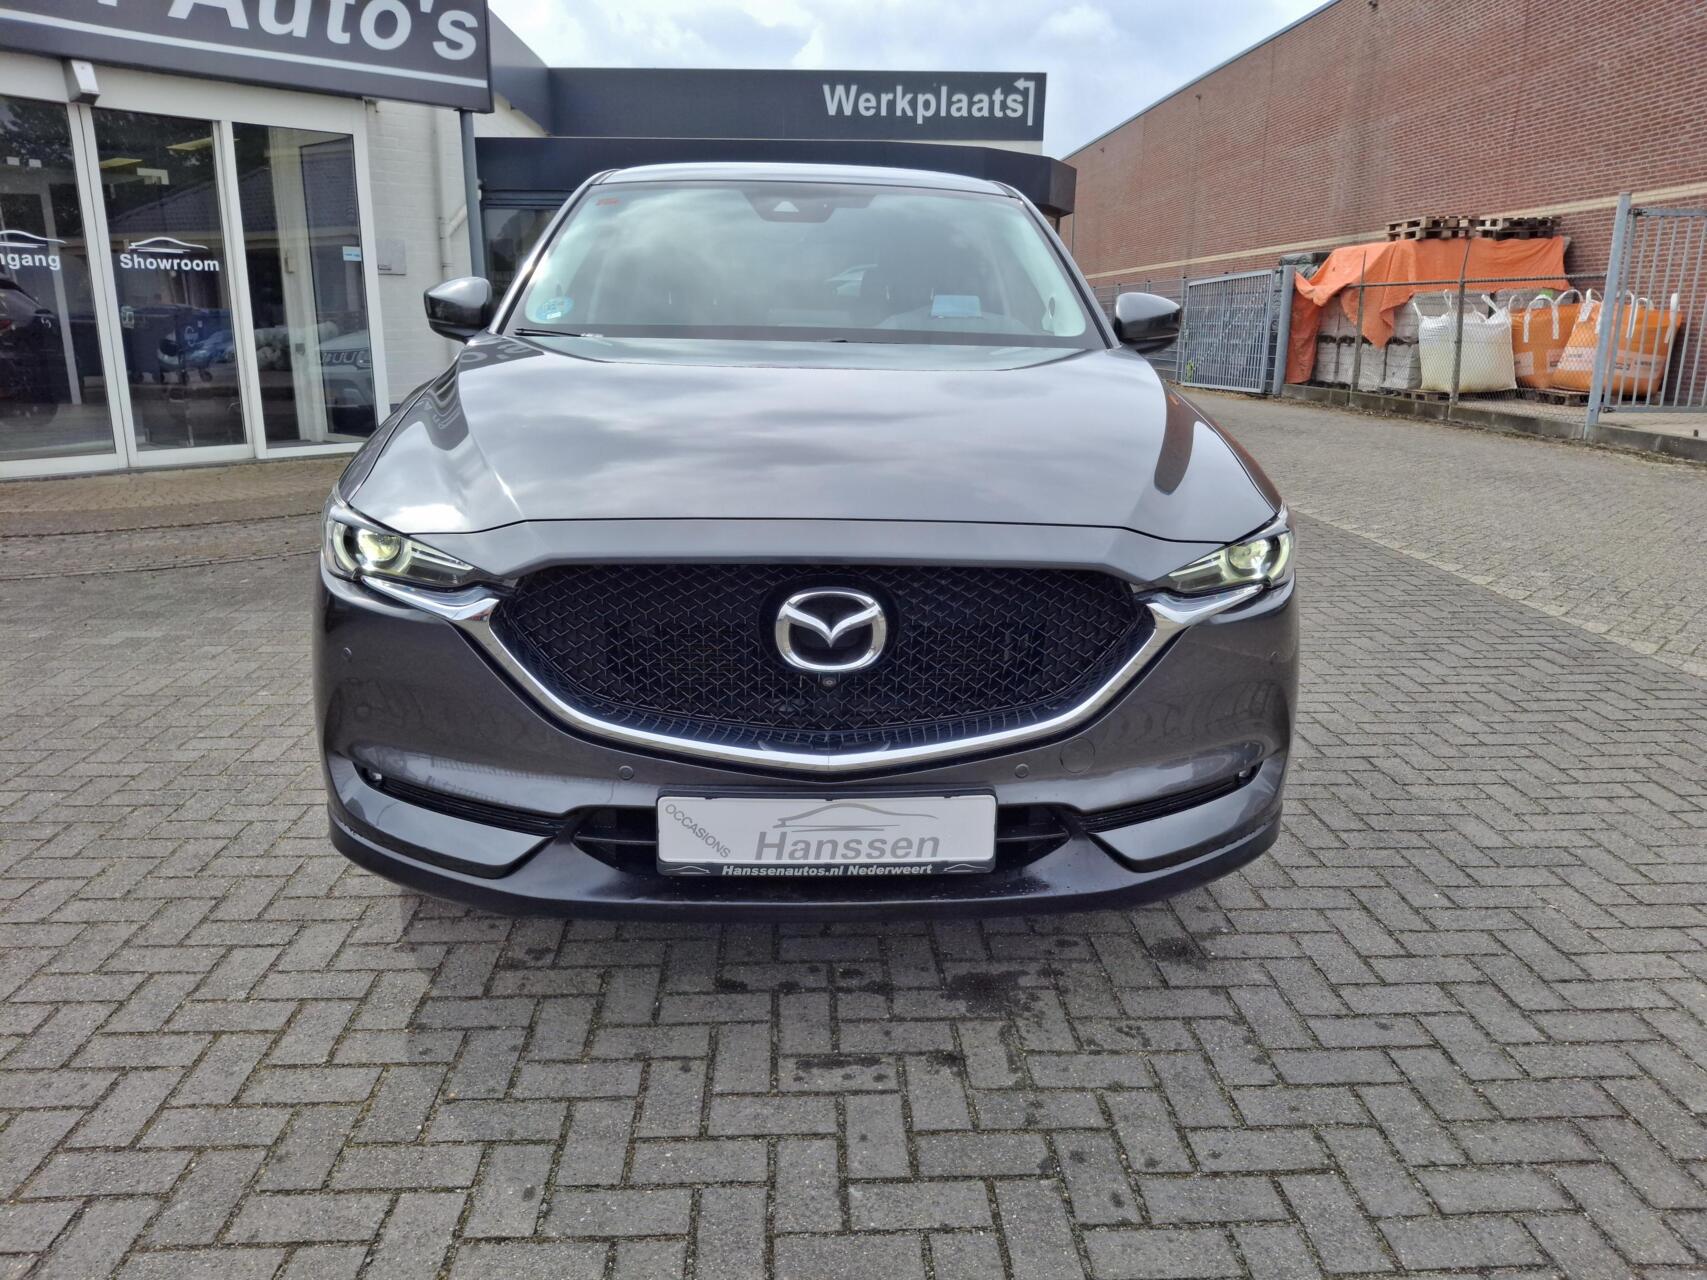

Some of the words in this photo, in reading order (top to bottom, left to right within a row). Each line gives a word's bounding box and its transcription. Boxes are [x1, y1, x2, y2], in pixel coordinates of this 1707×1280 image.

[822, 83, 1024, 125] Werkplaats
[119, 253, 220, 271] Showroom
[664, 803, 732, 859] OCCASIONS
[754, 831, 940, 861] Hanssen
[721, 864, 843, 876] Hanssenautos.nl
[847, 863, 933, 876] Nederweert
